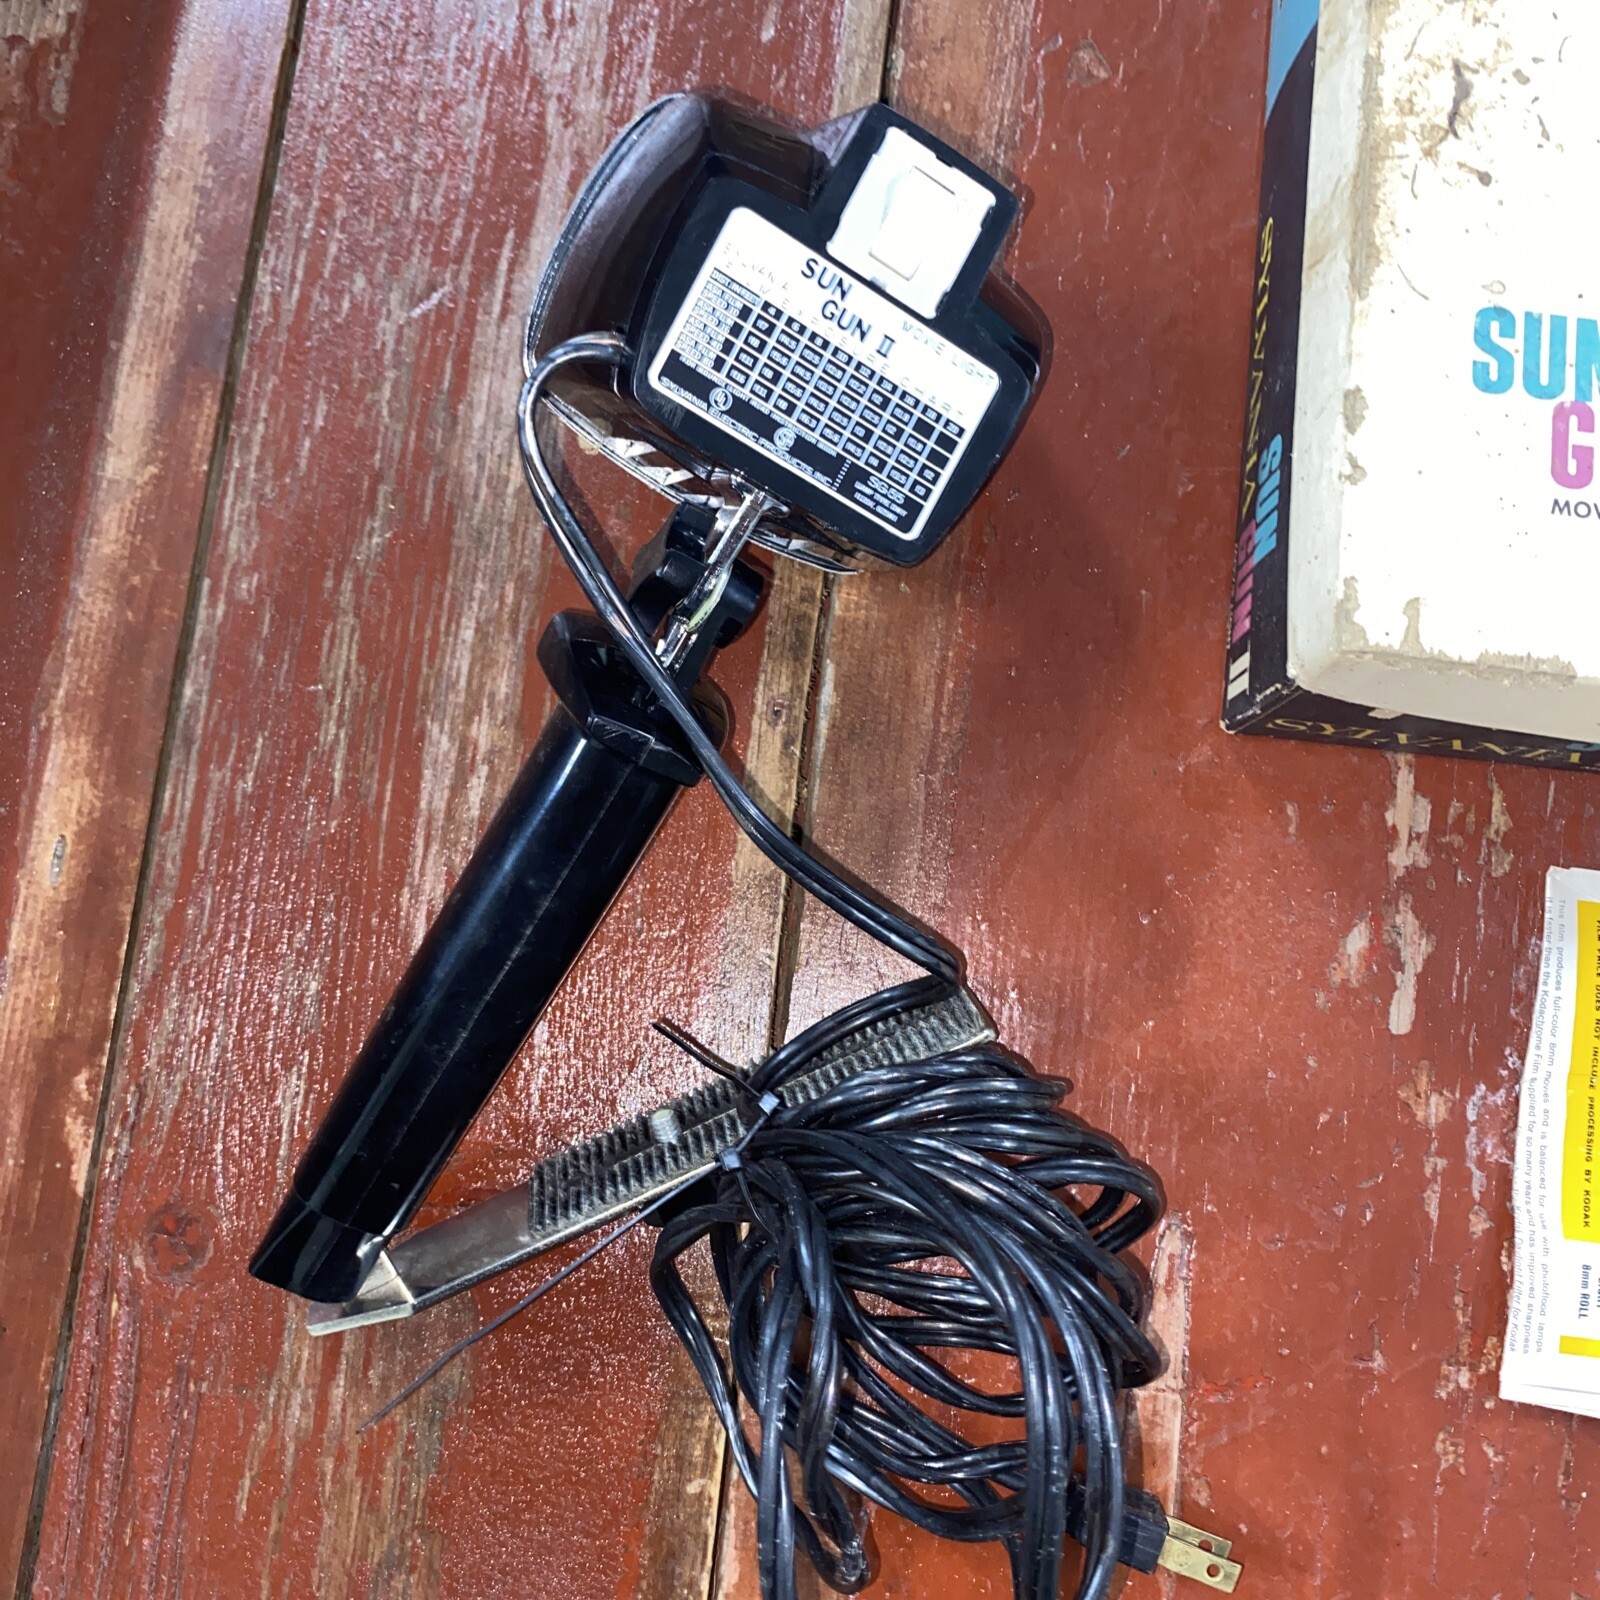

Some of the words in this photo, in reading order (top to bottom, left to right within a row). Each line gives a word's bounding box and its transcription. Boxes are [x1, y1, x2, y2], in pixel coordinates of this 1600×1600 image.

[799, 255, 852, 302] SUN
[701, 288, 728, 310] SPEED
[721, 291, 744, 310] FILM
[692, 305, 719, 326] SPEED
[712, 308, 735, 327] FILM
[818, 296, 872, 343] GUN
[874, 332, 896, 359] II
[683, 322, 710, 343] SPEED
[703, 325, 725, 344] FILM
[674, 339, 702, 360] SPEED
[694, 342, 717, 361] FILM
[766, 304, 777, 316] 4
[790, 320, 801, 332] 6
[835, 349, 849, 363] 10
[858, 364, 871, 377] 12
[903, 393, 916, 406] 16
[945, 421, 960, 435] 20
[658, 375, 710, 411] SYLVANIA
[707, 405, 759, 442] ELECTRIC
[1256, 433, 1283, 565] SUN
[1231, 518, 1258, 644] GUN
[1226, 640, 1250, 709] II
[1557, 899, 1566, 919] This
[1544, 917, 1553, 944] faster
[1557, 923, 1565, 942] film
[1542, 947, 1552, 968] than
[1554, 947, 1564, 991] produces
[1541, 971, 1550, 987] the
[1534, 990, 1549, 1051] Kodachrome
[1549, 996, 1561, 1038] full-color
[1592, 1018, 1600, 1040] NOT
[1531, 1054, 1542, 1074] Film
[1546, 1042, 1557, 1066] 8mm
[1542, 1071, 1552, 1103] movies
[1527, 1120, 1536, 1133] for
[1541, 1108, 1550, 1127] and
[1584, 1096, 1594, 1162] PROCESSING
[1525, 1136, 1532, 1147] so
[1523, 1150, 1532, 1177] many
[1538, 1145, 1548, 1189] balanced
[1583, 1169, 1591, 1184] BY
[1523, 1180, 1532, 1206] years
[1538, 1194, 1546, 1208] for
[1525, 1208, 1536, 1227] and
[1582, 1189, 1590, 1228] KODAK
[1538, 1213, 1547, 1230] use
[1528, 1230, 1536, 1248] has
[1541, 1236, 1550, 1257] with
[1526, 1252, 1536, 1299] improved
[1580, 1264, 1592, 1289] 8mm
[1513, 1280, 1524, 1304] Filter
[1538, 1263, 1550, 1317] photoflood
[1511, 1306, 1521, 1320] for
[1577, 1293, 1590, 1319] ROLL
[1508, 1322, 1519, 1352] Kodak
[1522, 1303, 1534, 1354] sharpness
[1534, 1322, 1545, 1353] lamps
